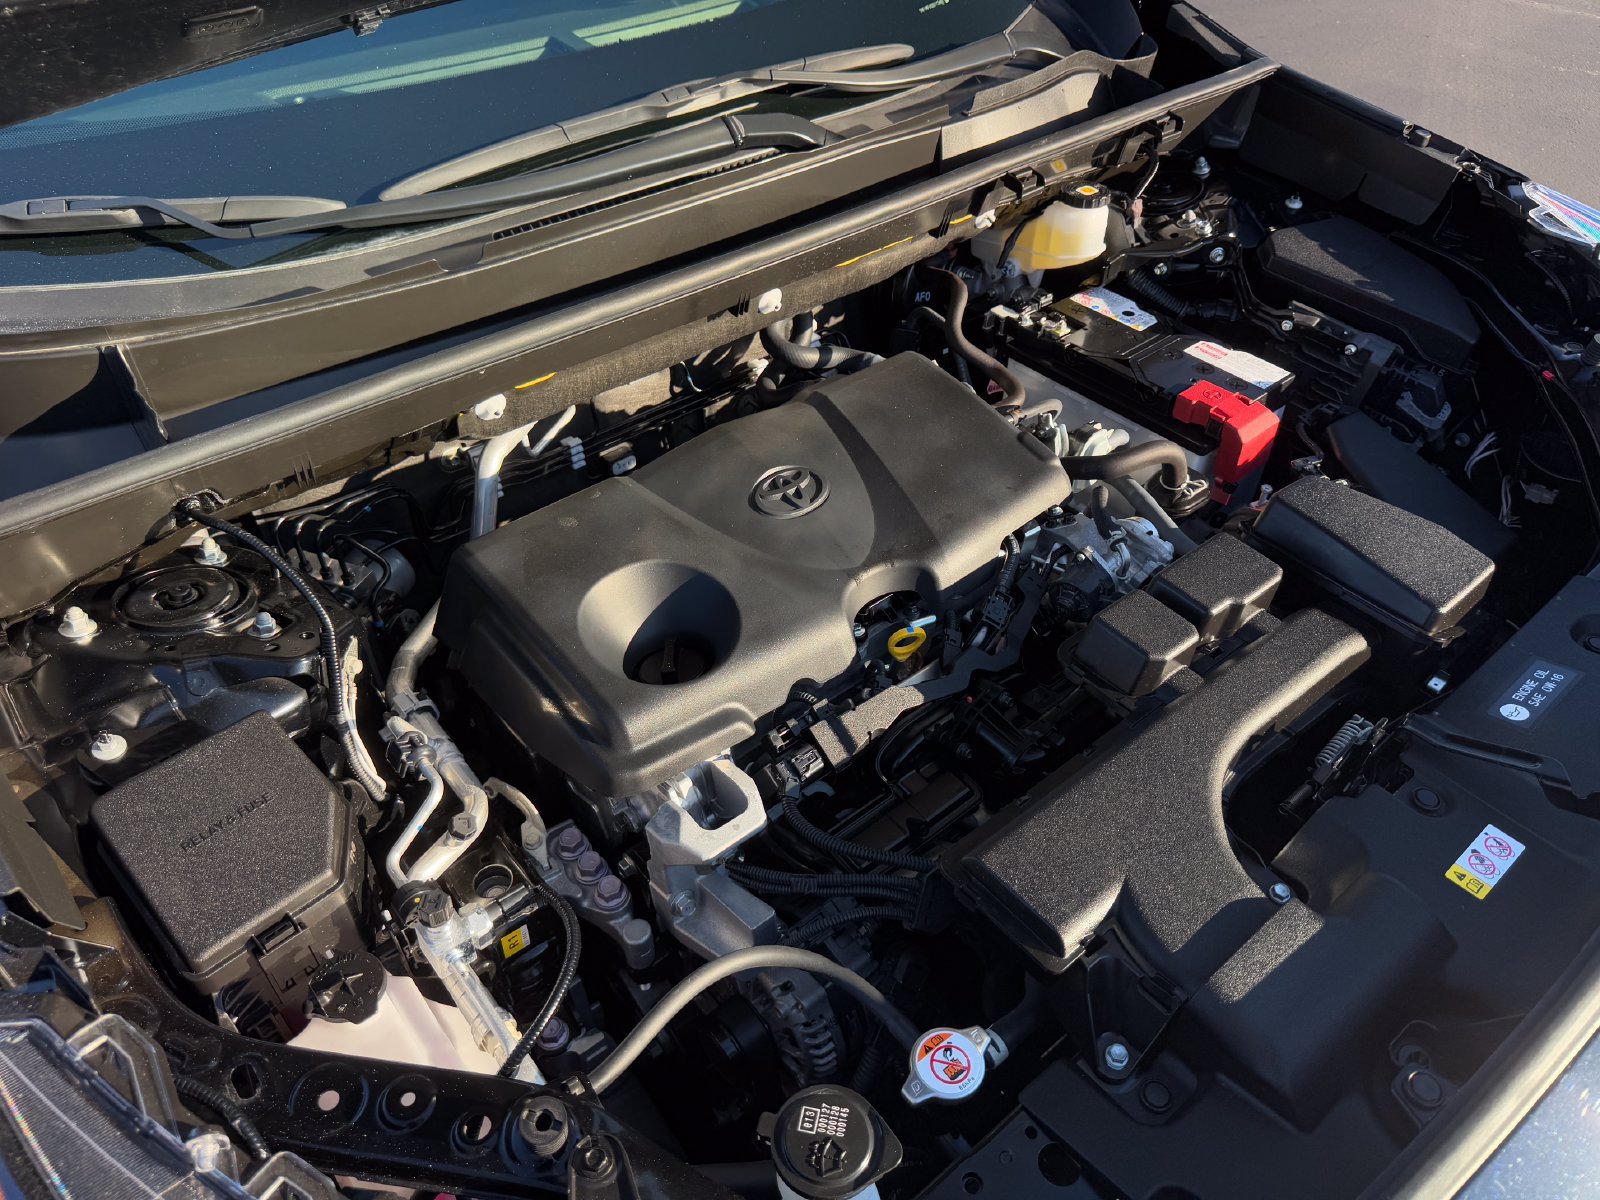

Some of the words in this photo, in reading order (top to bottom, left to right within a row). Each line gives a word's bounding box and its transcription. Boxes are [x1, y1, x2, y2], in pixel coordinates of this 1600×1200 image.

[1511, 678, 1539, 702] ENGINE
[1533, 669, 1550, 679] OIL
[1527, 692, 1547, 707] SAE
[1541, 673, 1564, 693] 0W-16
[180, 820, 224, 853] RELAY
[226, 814, 237, 825] &
[236, 792, 275, 818] FUSE
[507, 933, 520, 950] R1
[803, 1110, 816, 1128] e13
[817, 1102, 832, 1134] 000127
[826, 1105, 841, 1136] 000128
[835, 1107, 850, 1138] 000145
